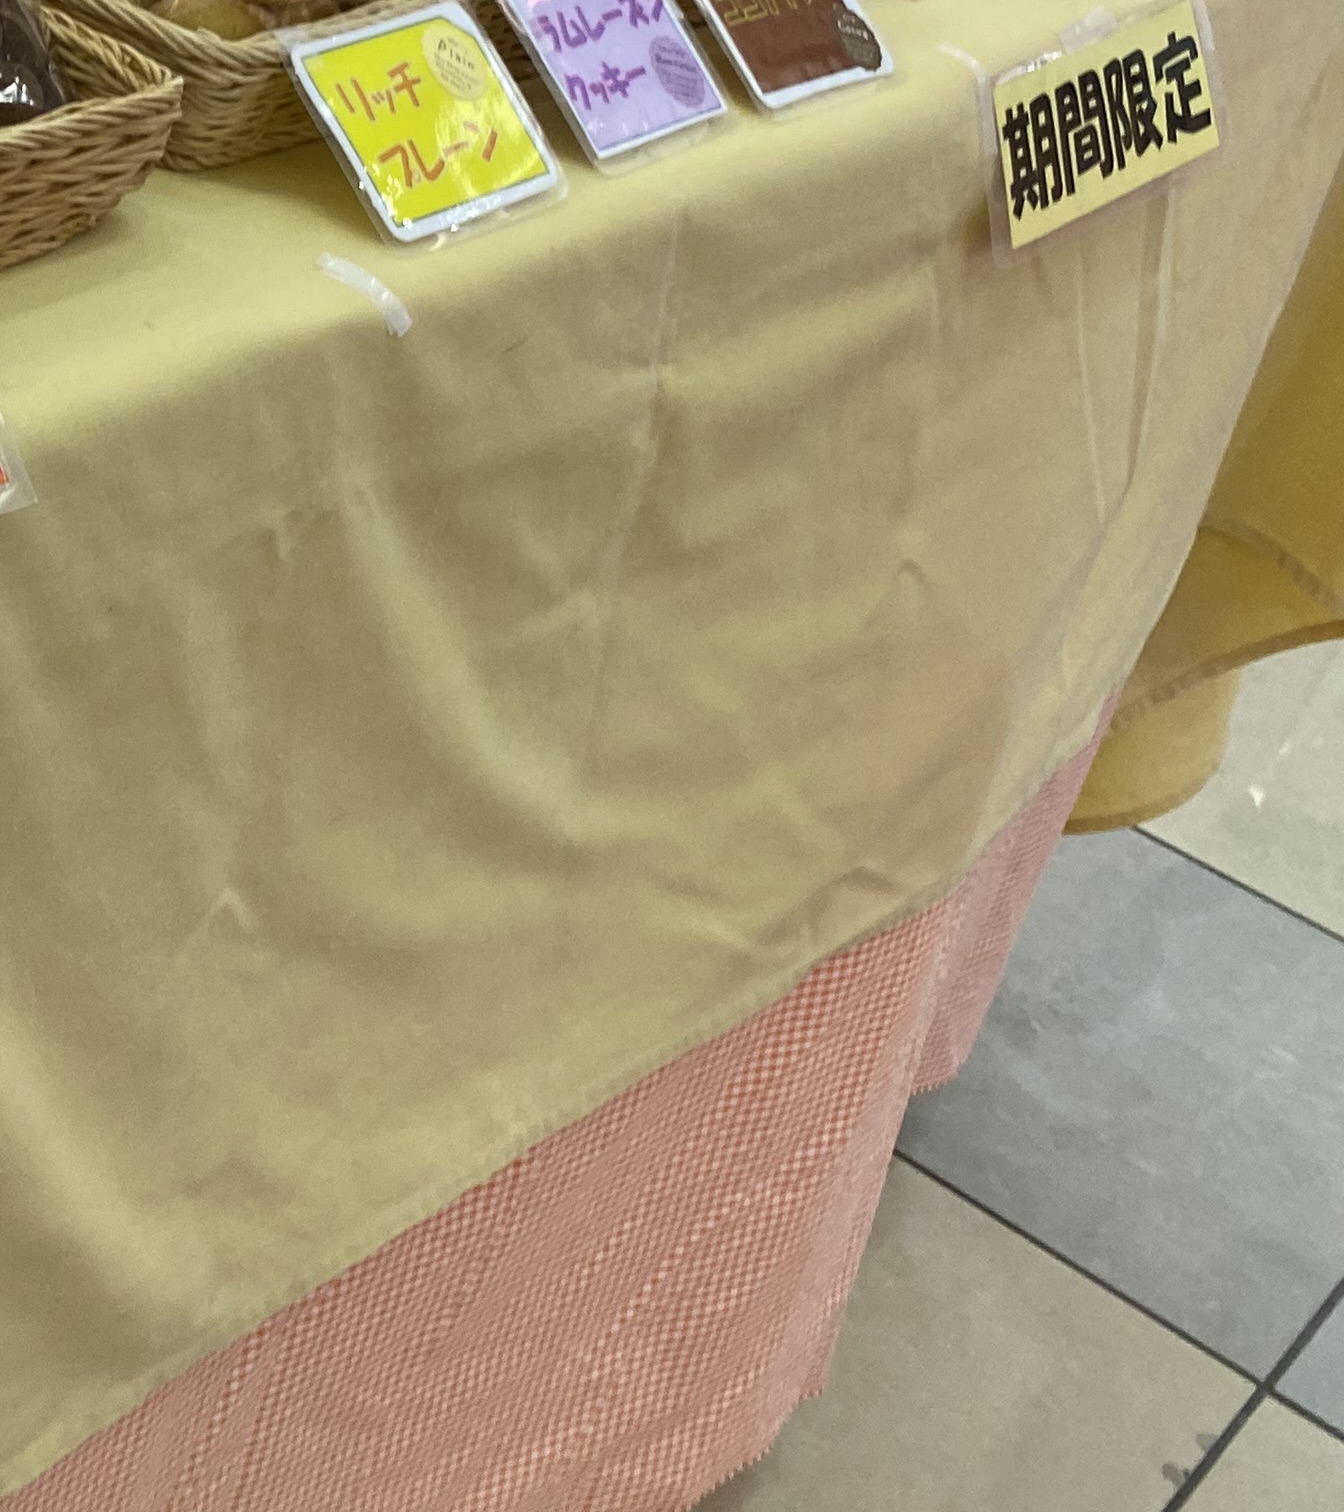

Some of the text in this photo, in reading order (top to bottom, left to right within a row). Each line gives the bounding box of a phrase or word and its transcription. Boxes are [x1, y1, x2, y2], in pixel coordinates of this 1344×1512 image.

[335, 62, 421, 121] リッチ
[564, 61, 646, 111] クッキー
[378, 121, 498, 189] プレーン
[1001, 31, 1211, 219] 期間限定
